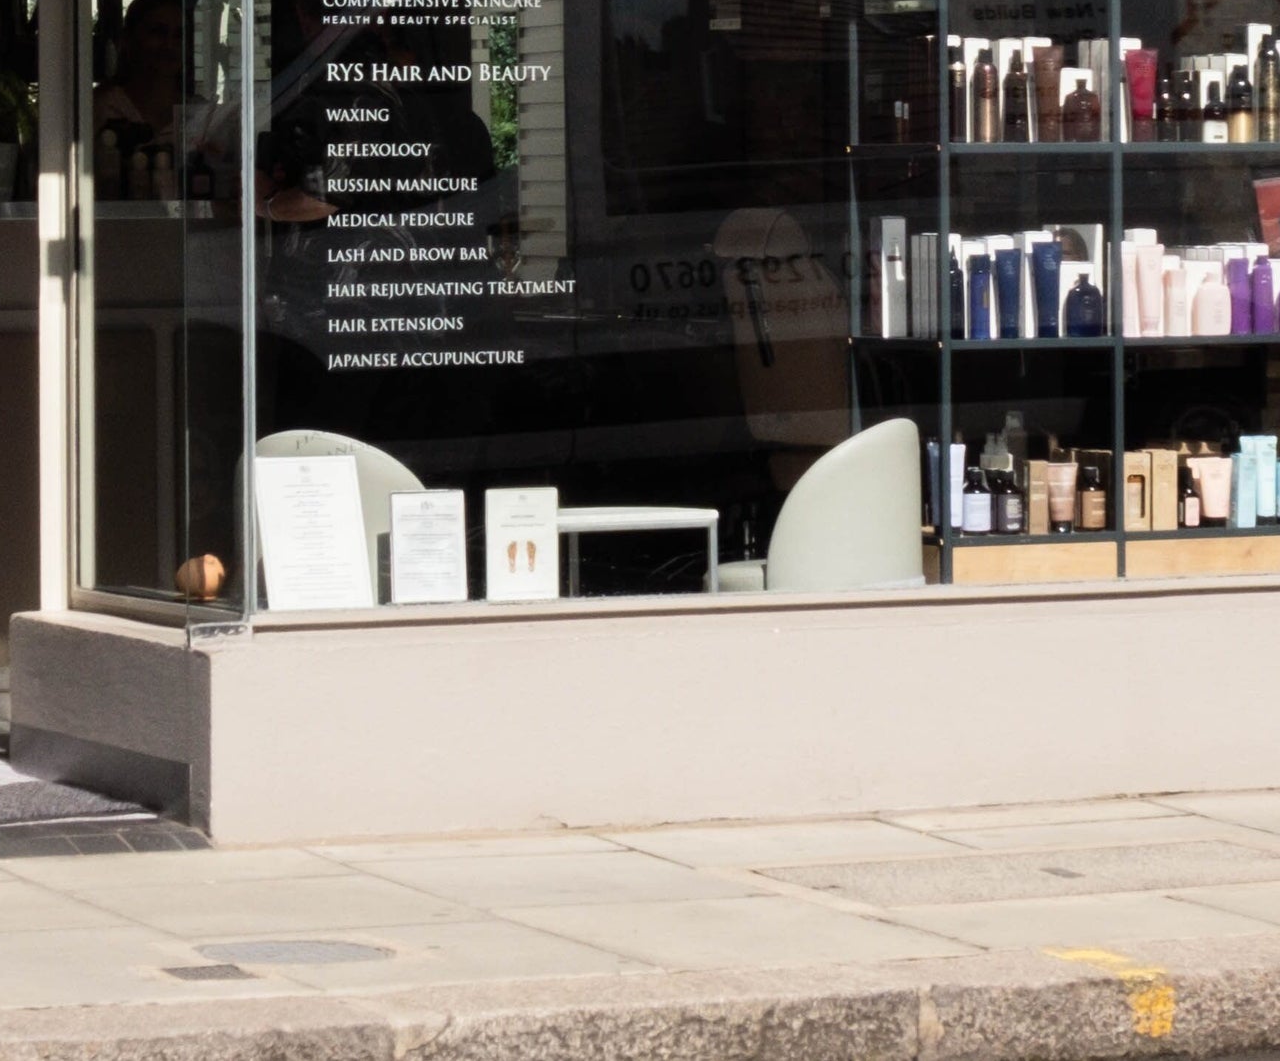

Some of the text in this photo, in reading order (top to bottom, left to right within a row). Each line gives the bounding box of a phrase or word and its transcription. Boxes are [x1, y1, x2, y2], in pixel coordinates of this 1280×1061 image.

[322, 15, 517, 26] HEALTH & BEAUTY SPECIALIST
[327, 62, 552, 82] RYS HAIR AND BEAUTY
[326, 108, 390, 122] WAXING
[327, 143, 432, 157] REFLEXOLOGY
[327, 177, 478, 193] RUSSIAN MANICURE
[327, 212, 474, 228] MEDICAL PEDICURE
[327, 246, 489, 263] LASH AND BROW BAR
[328, 280, 577, 299] HAIR REJUVENATING TREATMENT
[328, 316, 464, 333] HAIR EXTENSIONS
[327, 350, 524, 371] JAPANESE ACCUPUNCTURE
